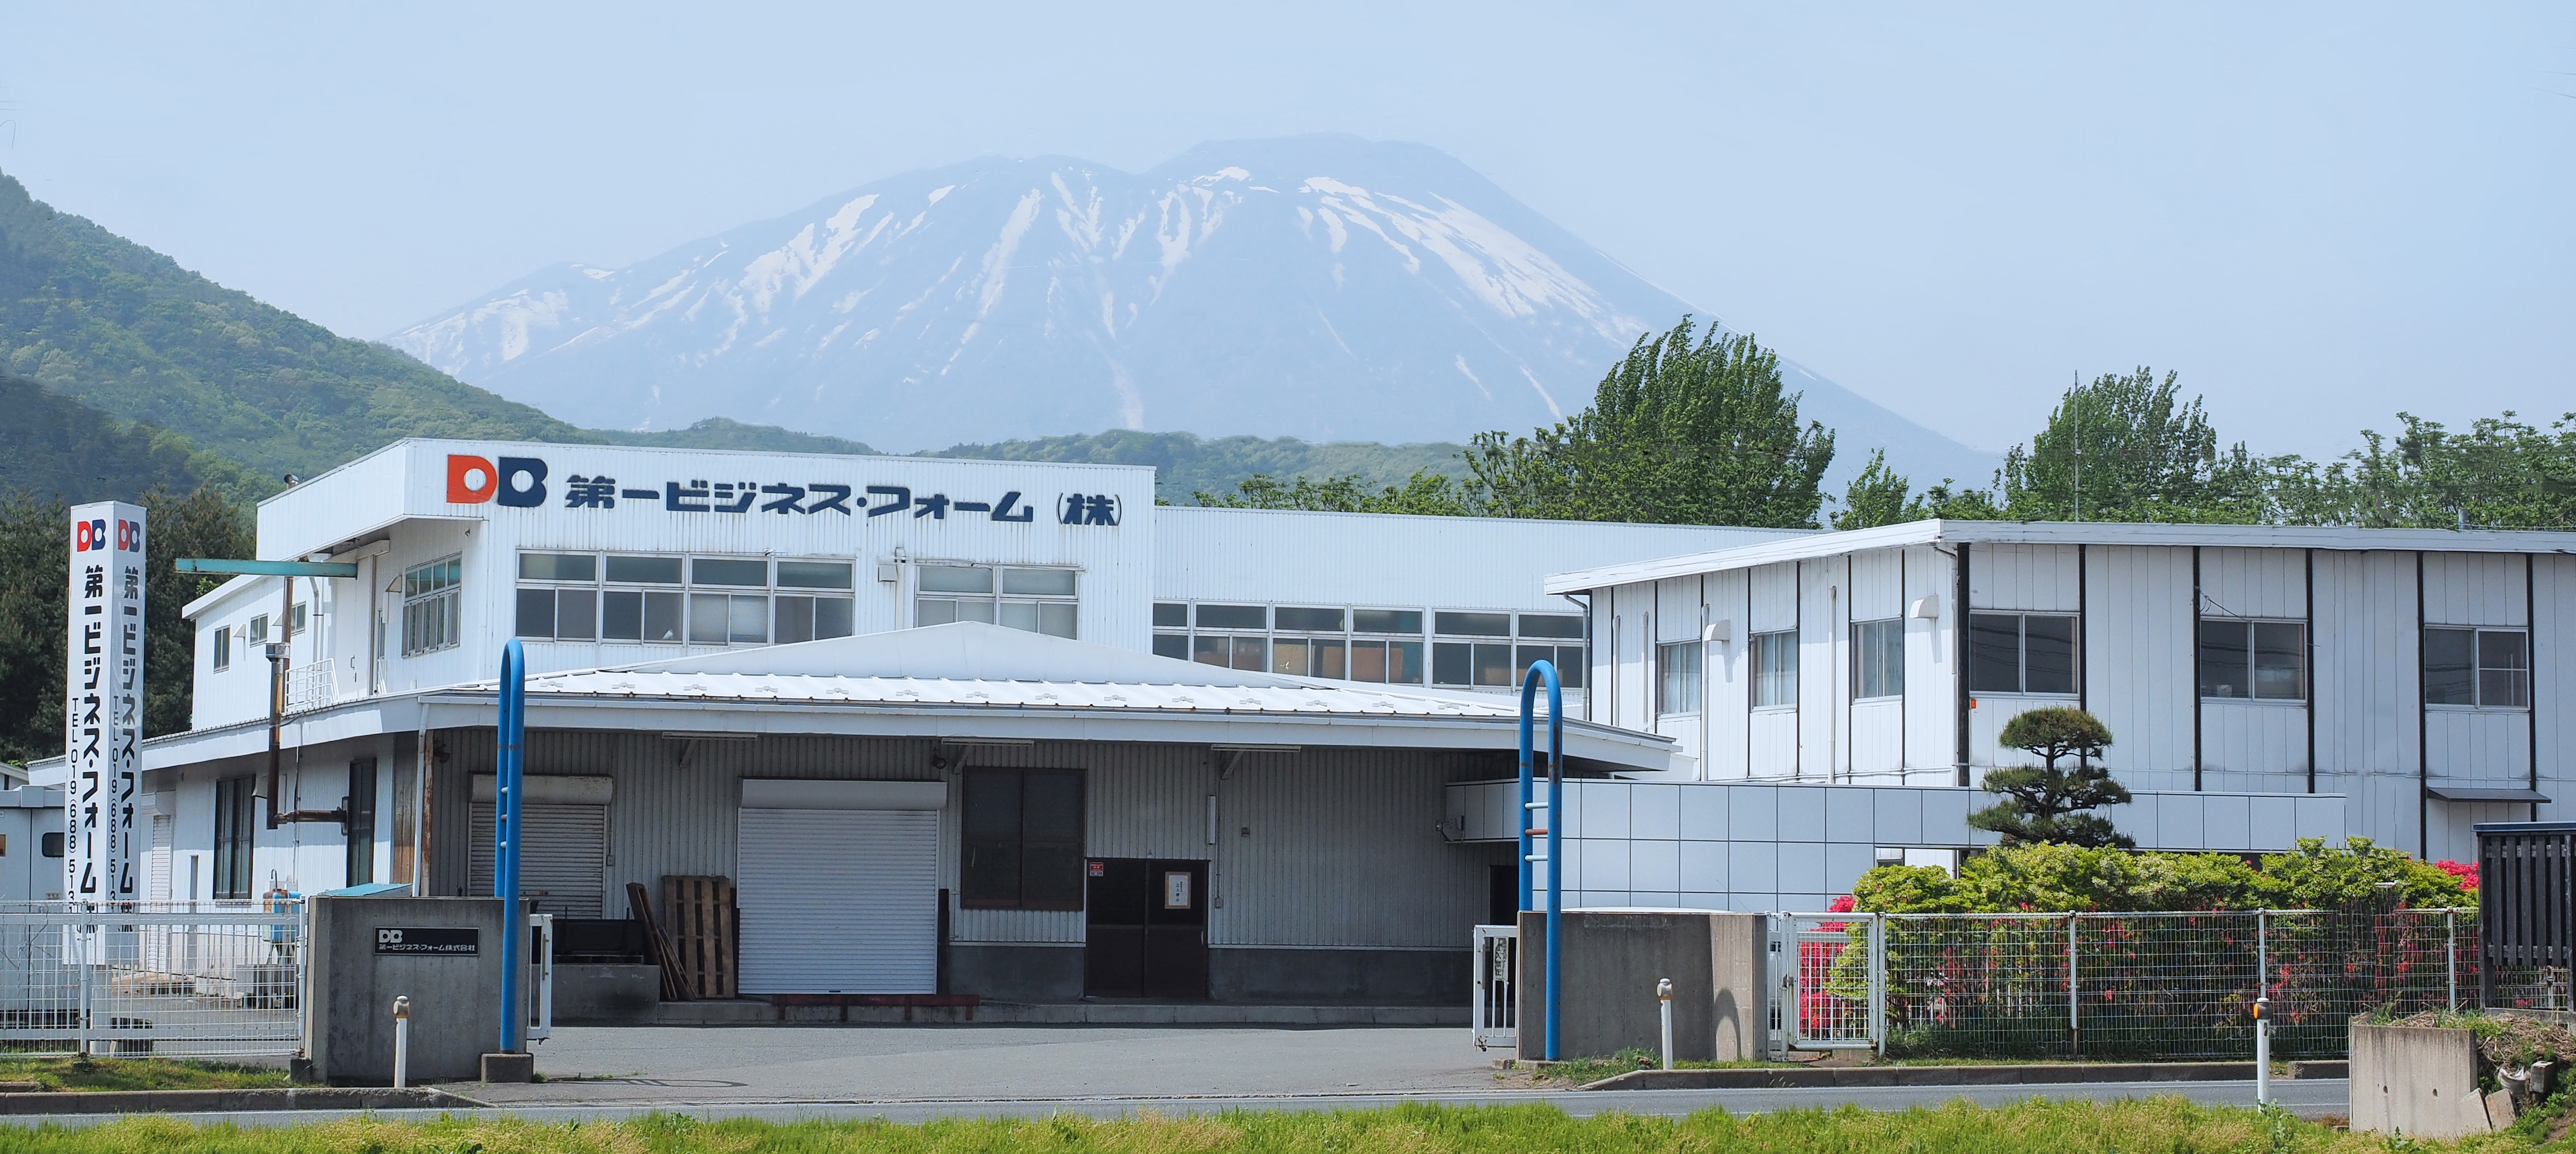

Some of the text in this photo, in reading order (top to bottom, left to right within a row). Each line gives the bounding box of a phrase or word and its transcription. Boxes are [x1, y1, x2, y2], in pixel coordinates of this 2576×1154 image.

[447, 454, 548, 508] DB
[77, 519, 106, 552] DB
[118, 519, 141, 553] DB
[379, 929, 403, 943] DB
